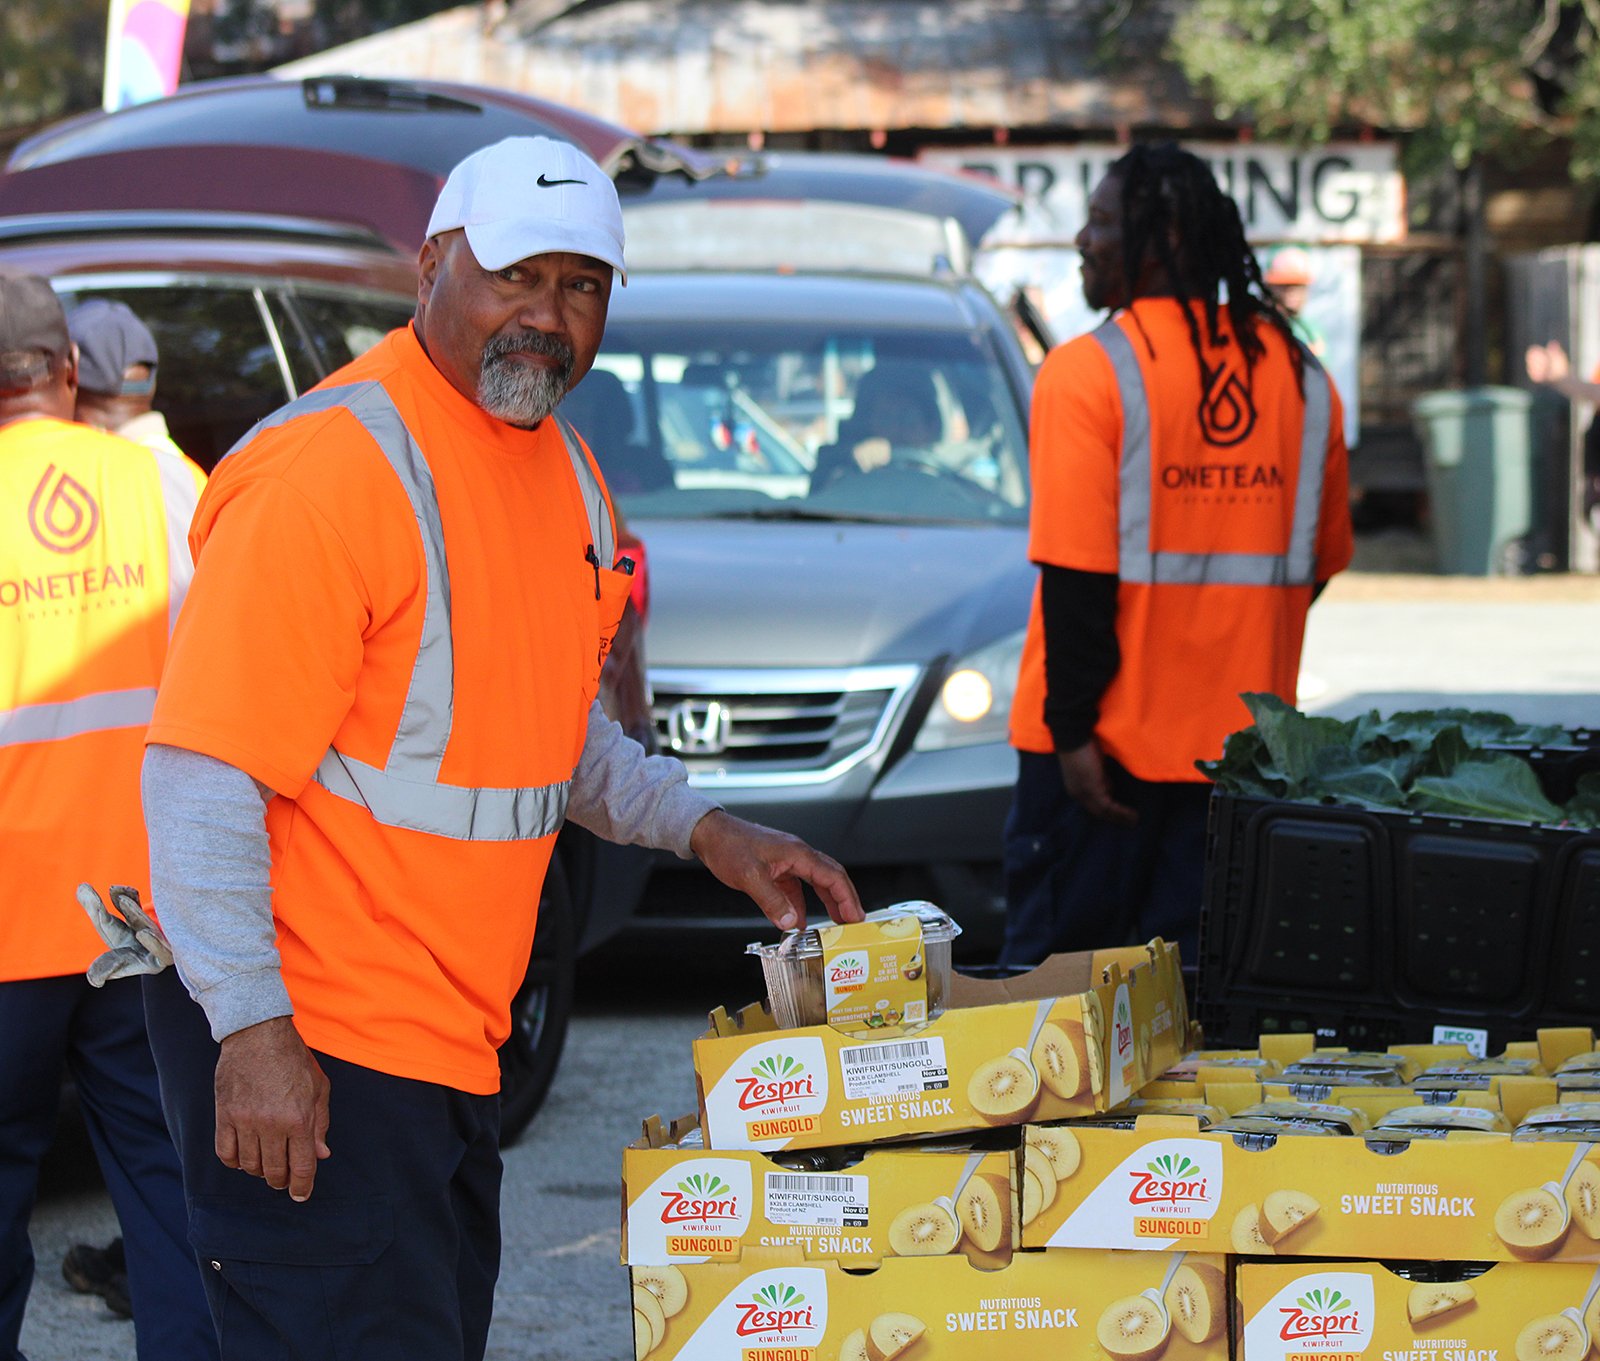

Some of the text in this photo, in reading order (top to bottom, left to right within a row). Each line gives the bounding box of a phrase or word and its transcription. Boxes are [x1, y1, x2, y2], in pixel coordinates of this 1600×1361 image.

[0, 564, 144, 606] ONETEAM
[830, 966, 864, 982] Zespri
[836, 985, 863, 993] SUNGOLD
[1317, 1028, 1336, 1037] IFCO
[1444, 1031, 1474, 1042] IFCO
[846, 1059, 933, 1075] KIWIFRUIT/SUNGOLD
[868, 1071, 901, 1080] CLAMSHELL
[848, 1079, 870, 1087] Product
[735, 1074, 817, 1111] Zespri
[869, 1091, 921, 1106] NUTRITIOUS
[761, 1104, 801, 1115] KIWIFRUIT
[840, 1098, 954, 1127] SWEET SNACK
[752, 1117, 814, 1137] SUNGOLD
[1129, 1172, 1208, 1205] Zespri
[1376, 1183, 1438, 1195] NUTRITIOUS
[768, 1192, 856, 1203] KIWIFRUIT/SUNGOLD
[660, 1192, 740, 1224] Zespri
[1341, 1195, 1475, 1217] SWEET SNACK
[789, 1226, 842, 1236] NUTRITIOUS
[1139, 1220, 1201, 1235] SUNGOLD
[671, 1238, 733, 1252] SUNGOLD
[818, 1237, 874, 1254] SNACK
[980, 1297, 1041, 1310] NUTRITIOUS
[735, 1303, 815, 1337] Zespri
[945, 1308, 1079, 1332] SWEET SNACK
[1279, 1308, 1361, 1341] Zespri
[758, 1335, 798, 1343] KIWIFRUIT
[1412, 1339, 1468, 1349] NUTRITIOUS
[748, 1349, 809, 1361] SUNGOLD
[1383, 1349, 1499, 1361] SWEET SNACK
